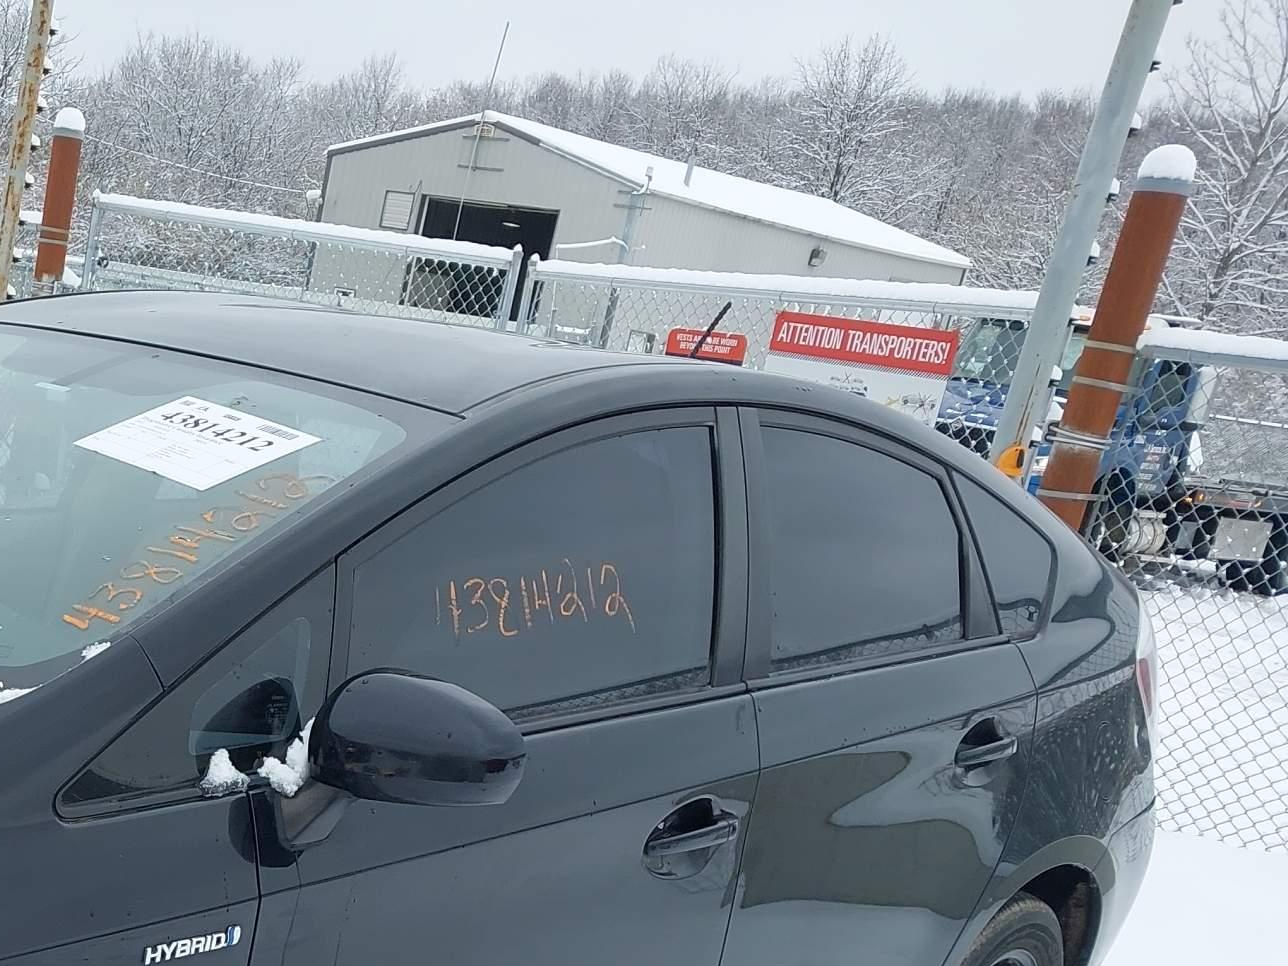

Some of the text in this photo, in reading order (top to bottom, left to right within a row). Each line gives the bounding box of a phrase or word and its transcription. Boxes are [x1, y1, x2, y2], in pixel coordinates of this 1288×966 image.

[777, 321, 952, 365] ATTENTION TRANSPORTERS!
[161, 411, 274, 452] 43814212
[144, 932, 228, 966] HYBRID
